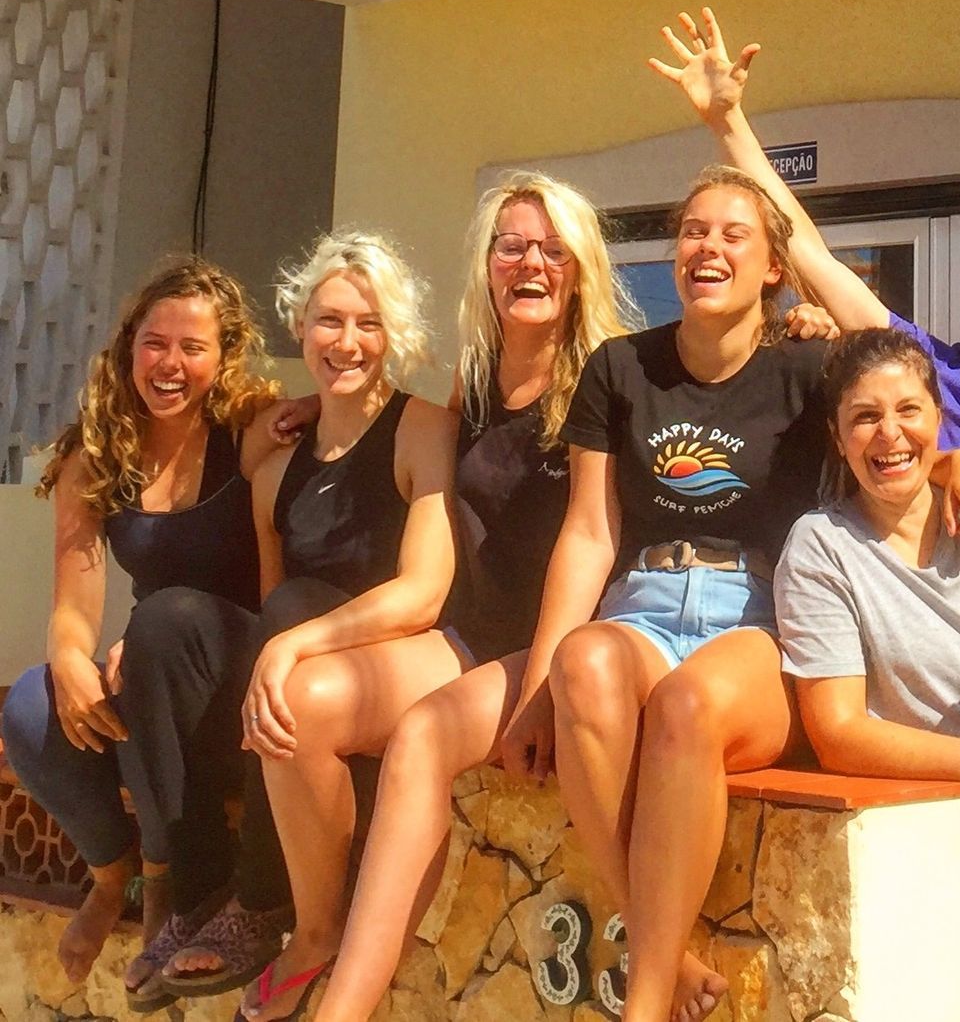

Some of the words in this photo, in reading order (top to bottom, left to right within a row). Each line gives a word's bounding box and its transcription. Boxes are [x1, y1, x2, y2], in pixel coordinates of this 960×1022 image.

[769, 153, 814, 176] CEPÇÃO
[648, 422, 703, 448] HAPPY
[708, 428, 745, 453] DAYS
[652, 495, 686, 514] SURF
